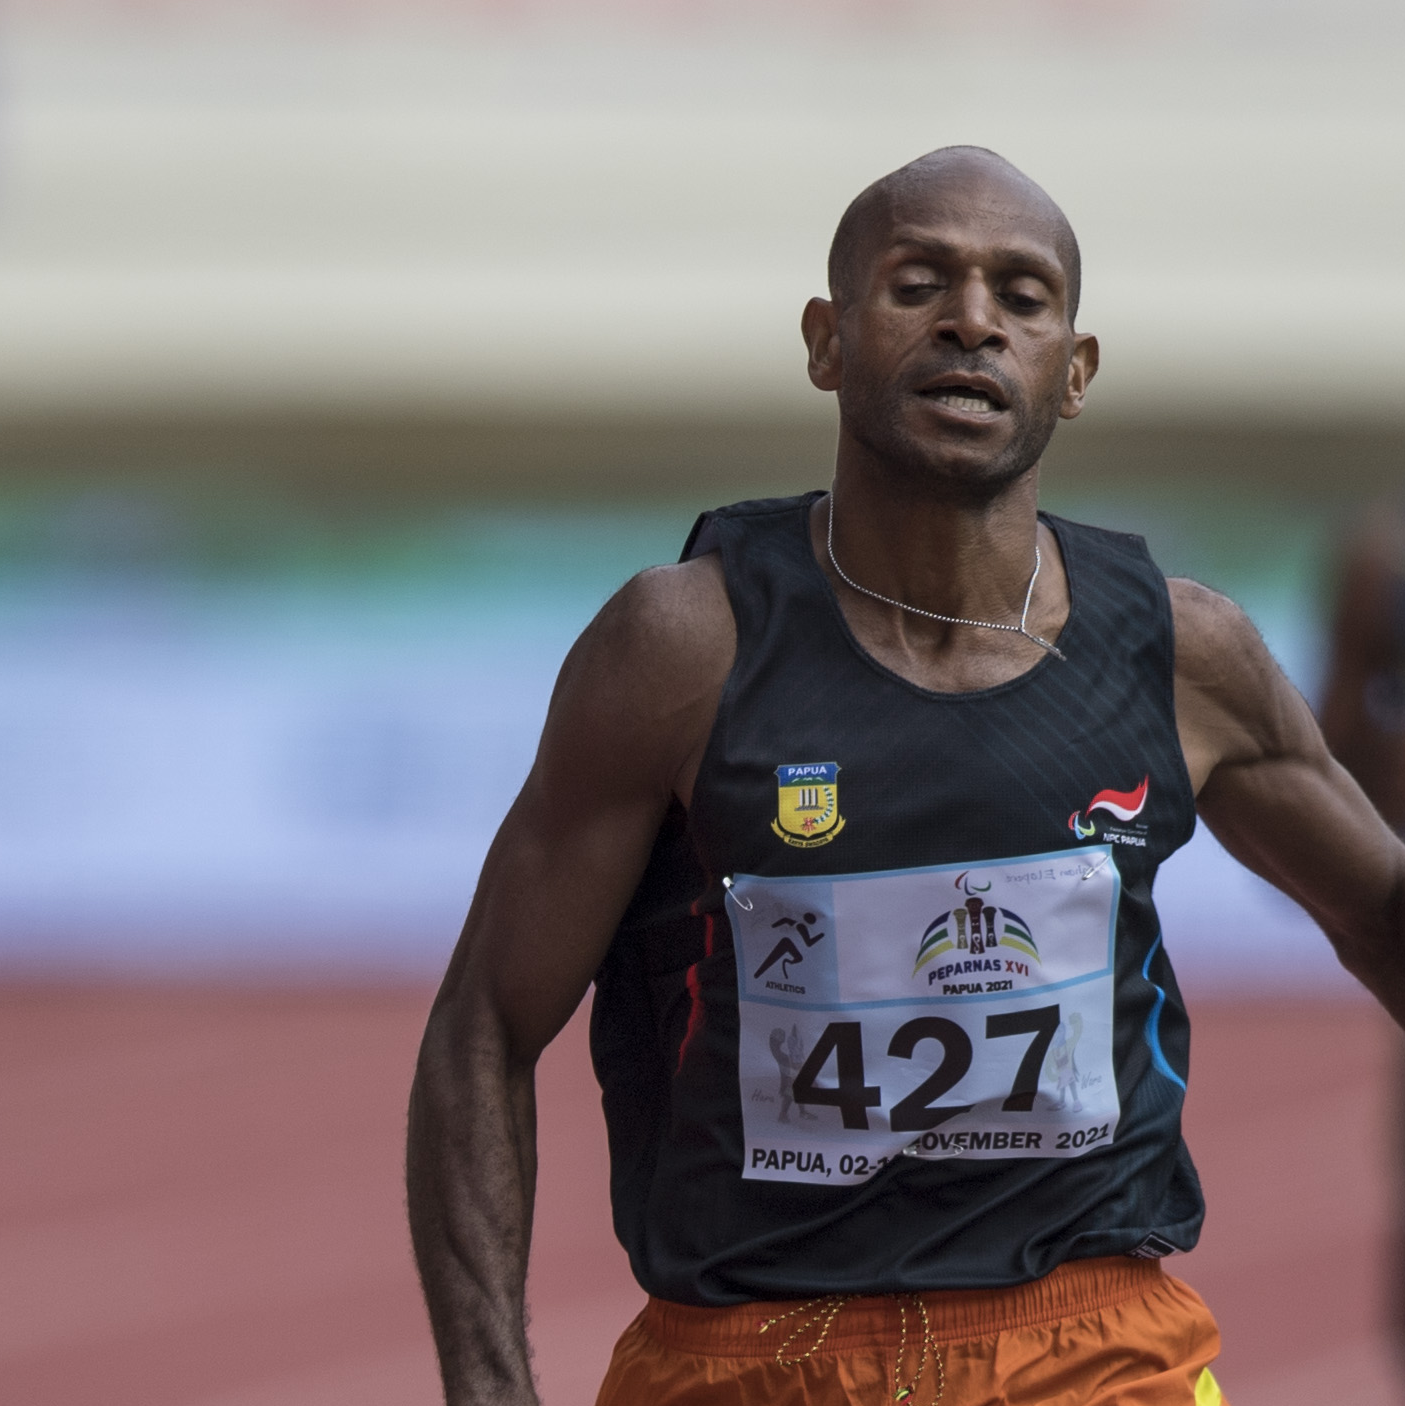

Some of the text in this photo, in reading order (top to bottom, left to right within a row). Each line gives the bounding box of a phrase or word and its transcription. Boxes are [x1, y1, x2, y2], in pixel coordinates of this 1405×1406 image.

[787, 765, 828, 777] PAPUA
[928, 959, 1029, 986] PEPARNAS XVI
[765, 980, 806, 995] ATHLETICS
[942, 980, 1013, 995] PAPUA 2021
[792, 1003, 1061, 1132] 427
[751, 1148, 832, 1178] PAPUA,
[1055, 1123, 1109, 1150] 2021
